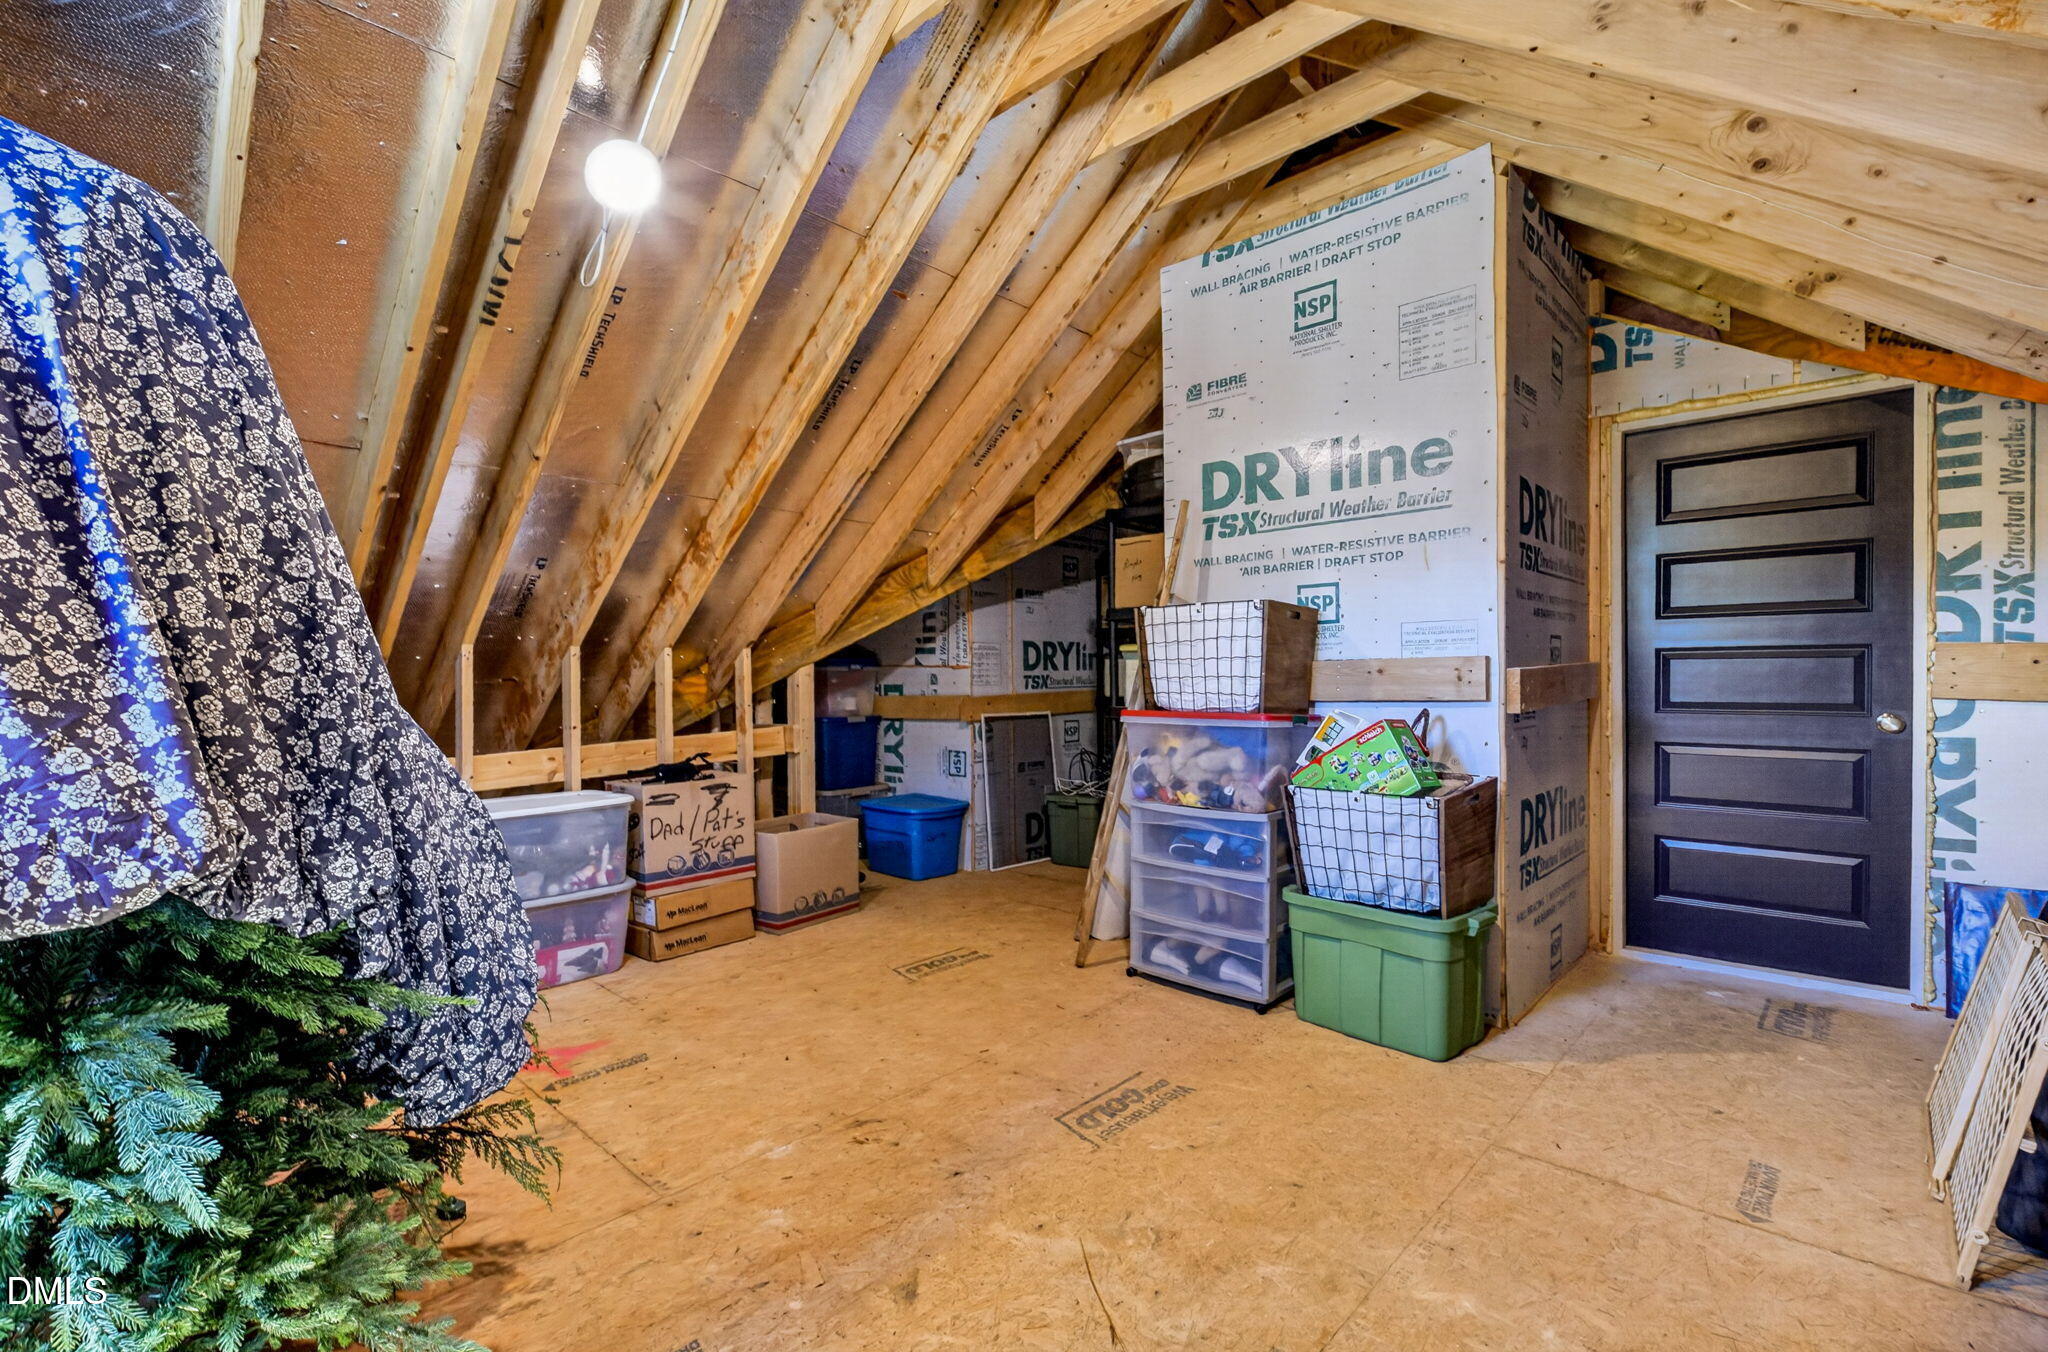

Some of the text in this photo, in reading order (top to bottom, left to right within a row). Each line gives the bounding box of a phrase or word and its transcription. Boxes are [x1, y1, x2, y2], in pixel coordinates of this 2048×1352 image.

[1191, 192, 1470, 298] WALL BRACING WATER-RESISTIVE BARRIER
[1239, 232, 1402, 295] AIR BARRIER DRAFT STOP
[610, 285, 627, 305] LP
[1294, 294, 1331, 321] NSP
[849, 359, 864, 375] LP
[1207, 372, 1247, 391] FIBRE
[1998, 416, 2025, 486] Weather
[1202, 486, 1453, 541] TSX Structural Weather Barrier
[1999, 490, 2025, 569] Structural
[1193, 527, 1471, 569] WALL BRACING WATER-RESISTIVE BARRIER
[1242, 550, 1404, 577] AIR BARRIER DRAFT STOP
[1023, 675, 1049, 690] TSX
[1520, 856, 1541, 891] TSX
[678, 902, 708, 915] MacLean
[676, 933, 707, 947] MacLean
[1076, 1088, 1146, 1130] GOLD
